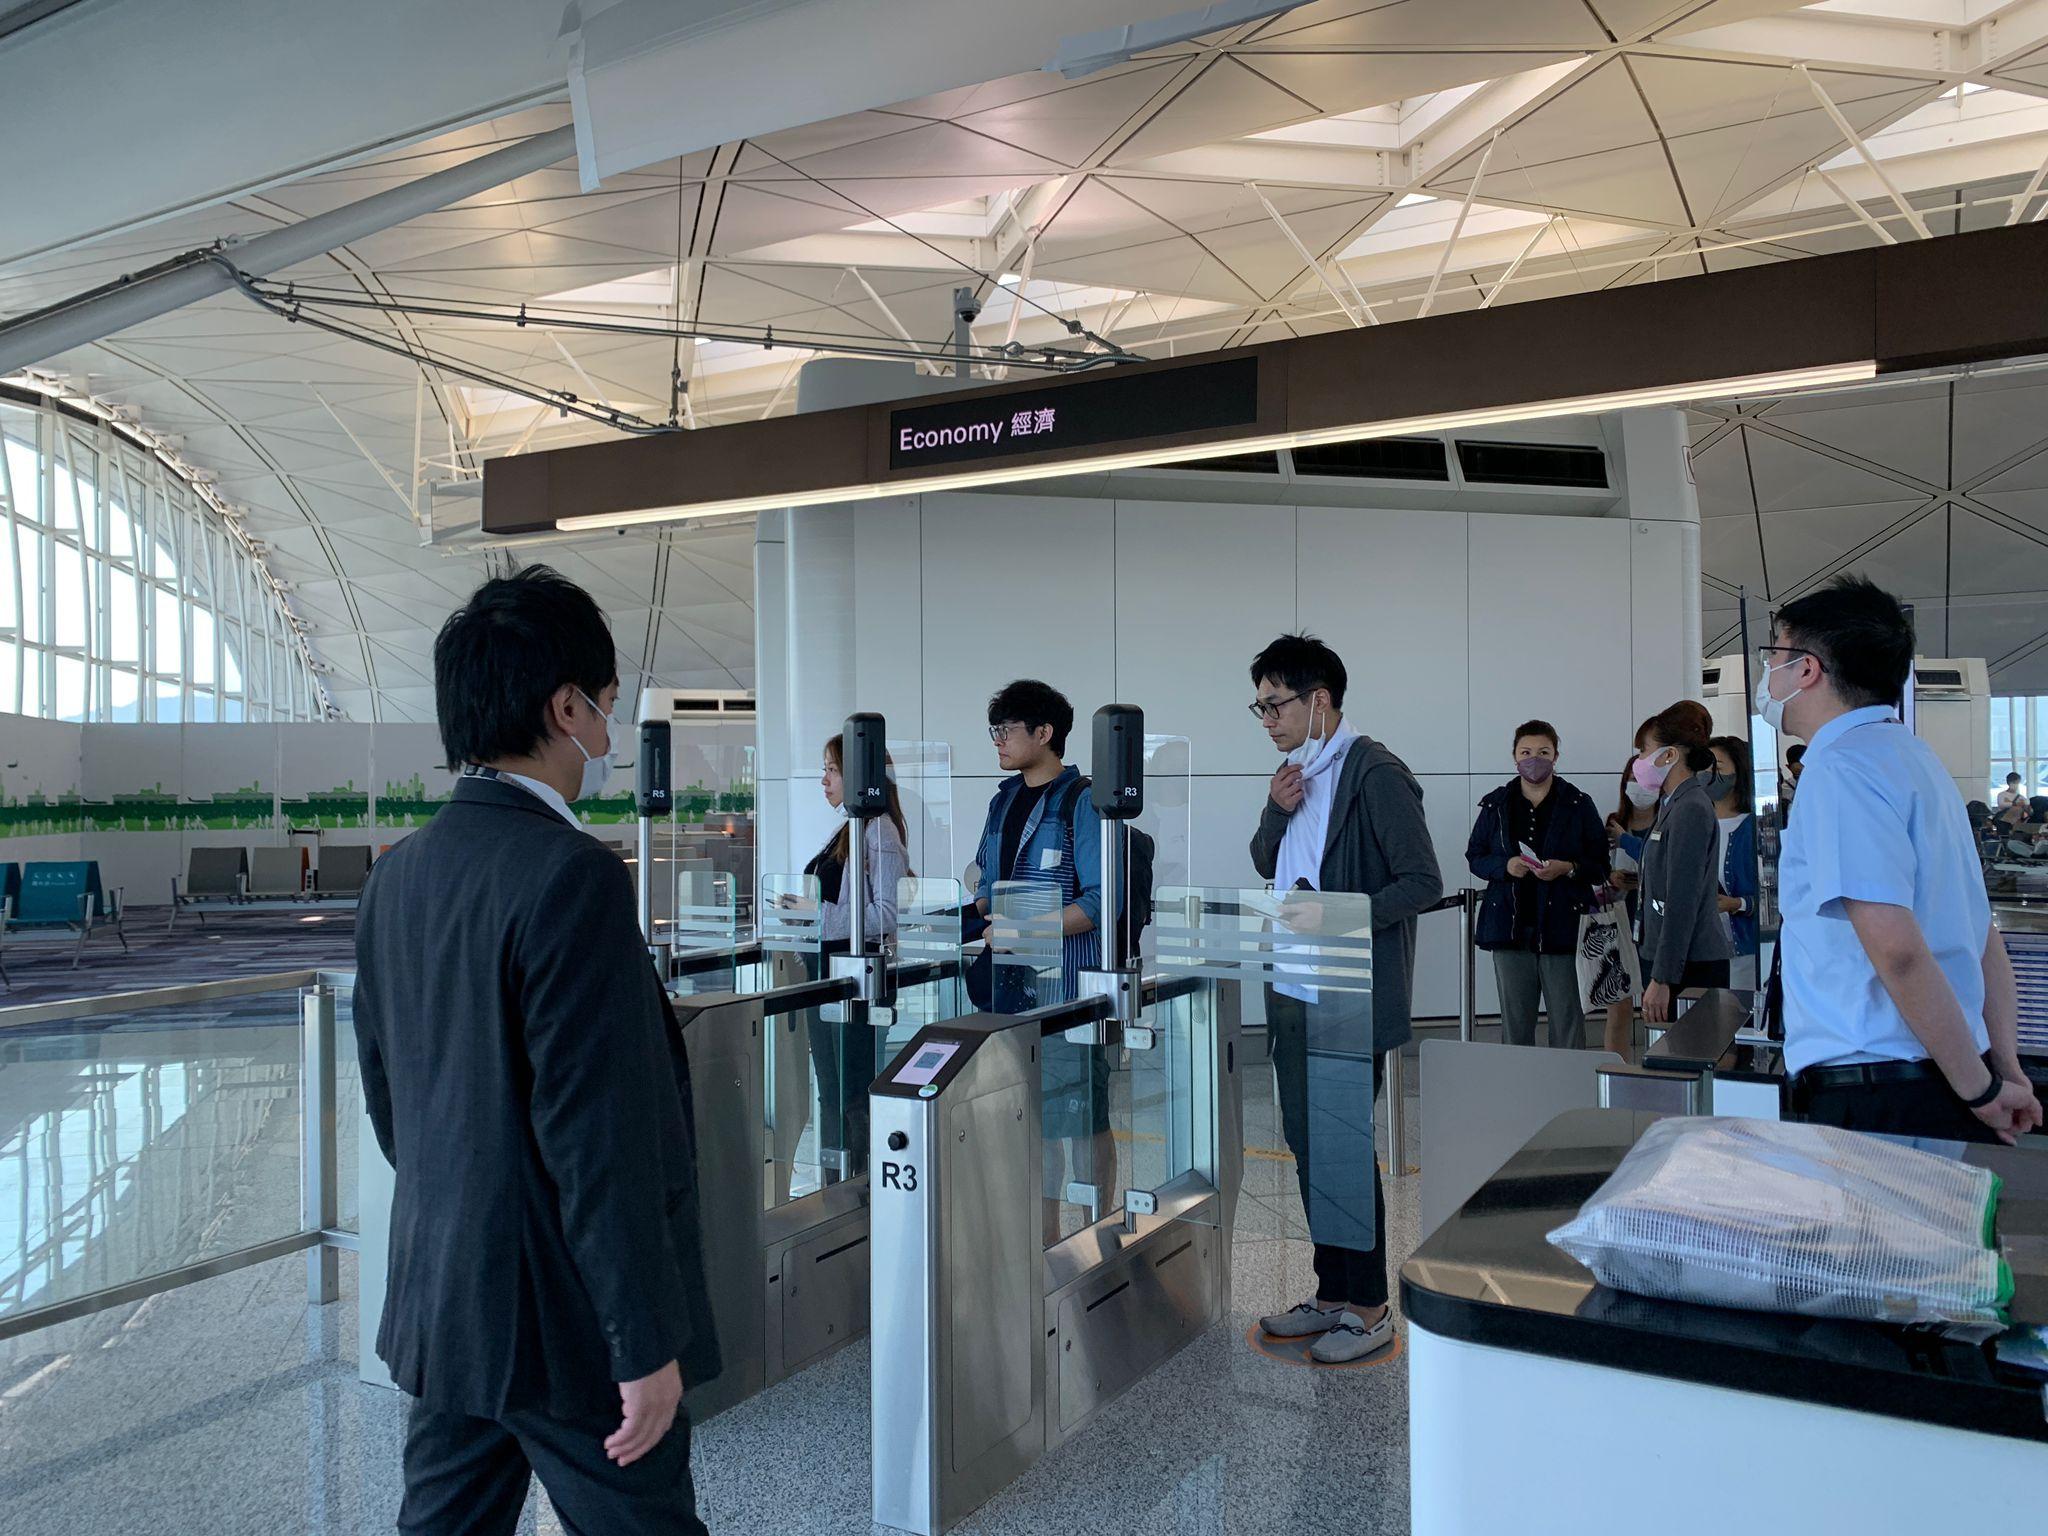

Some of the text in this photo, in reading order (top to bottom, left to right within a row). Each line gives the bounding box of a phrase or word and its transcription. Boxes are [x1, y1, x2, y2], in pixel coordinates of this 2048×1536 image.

[899, 407, 1056, 451] Economy 經濟
[652, 789, 665, 798] R5
[867, 787, 880, 797] R4
[1124, 787, 1137, 797] R3
[881, 1161, 918, 1192] R3
